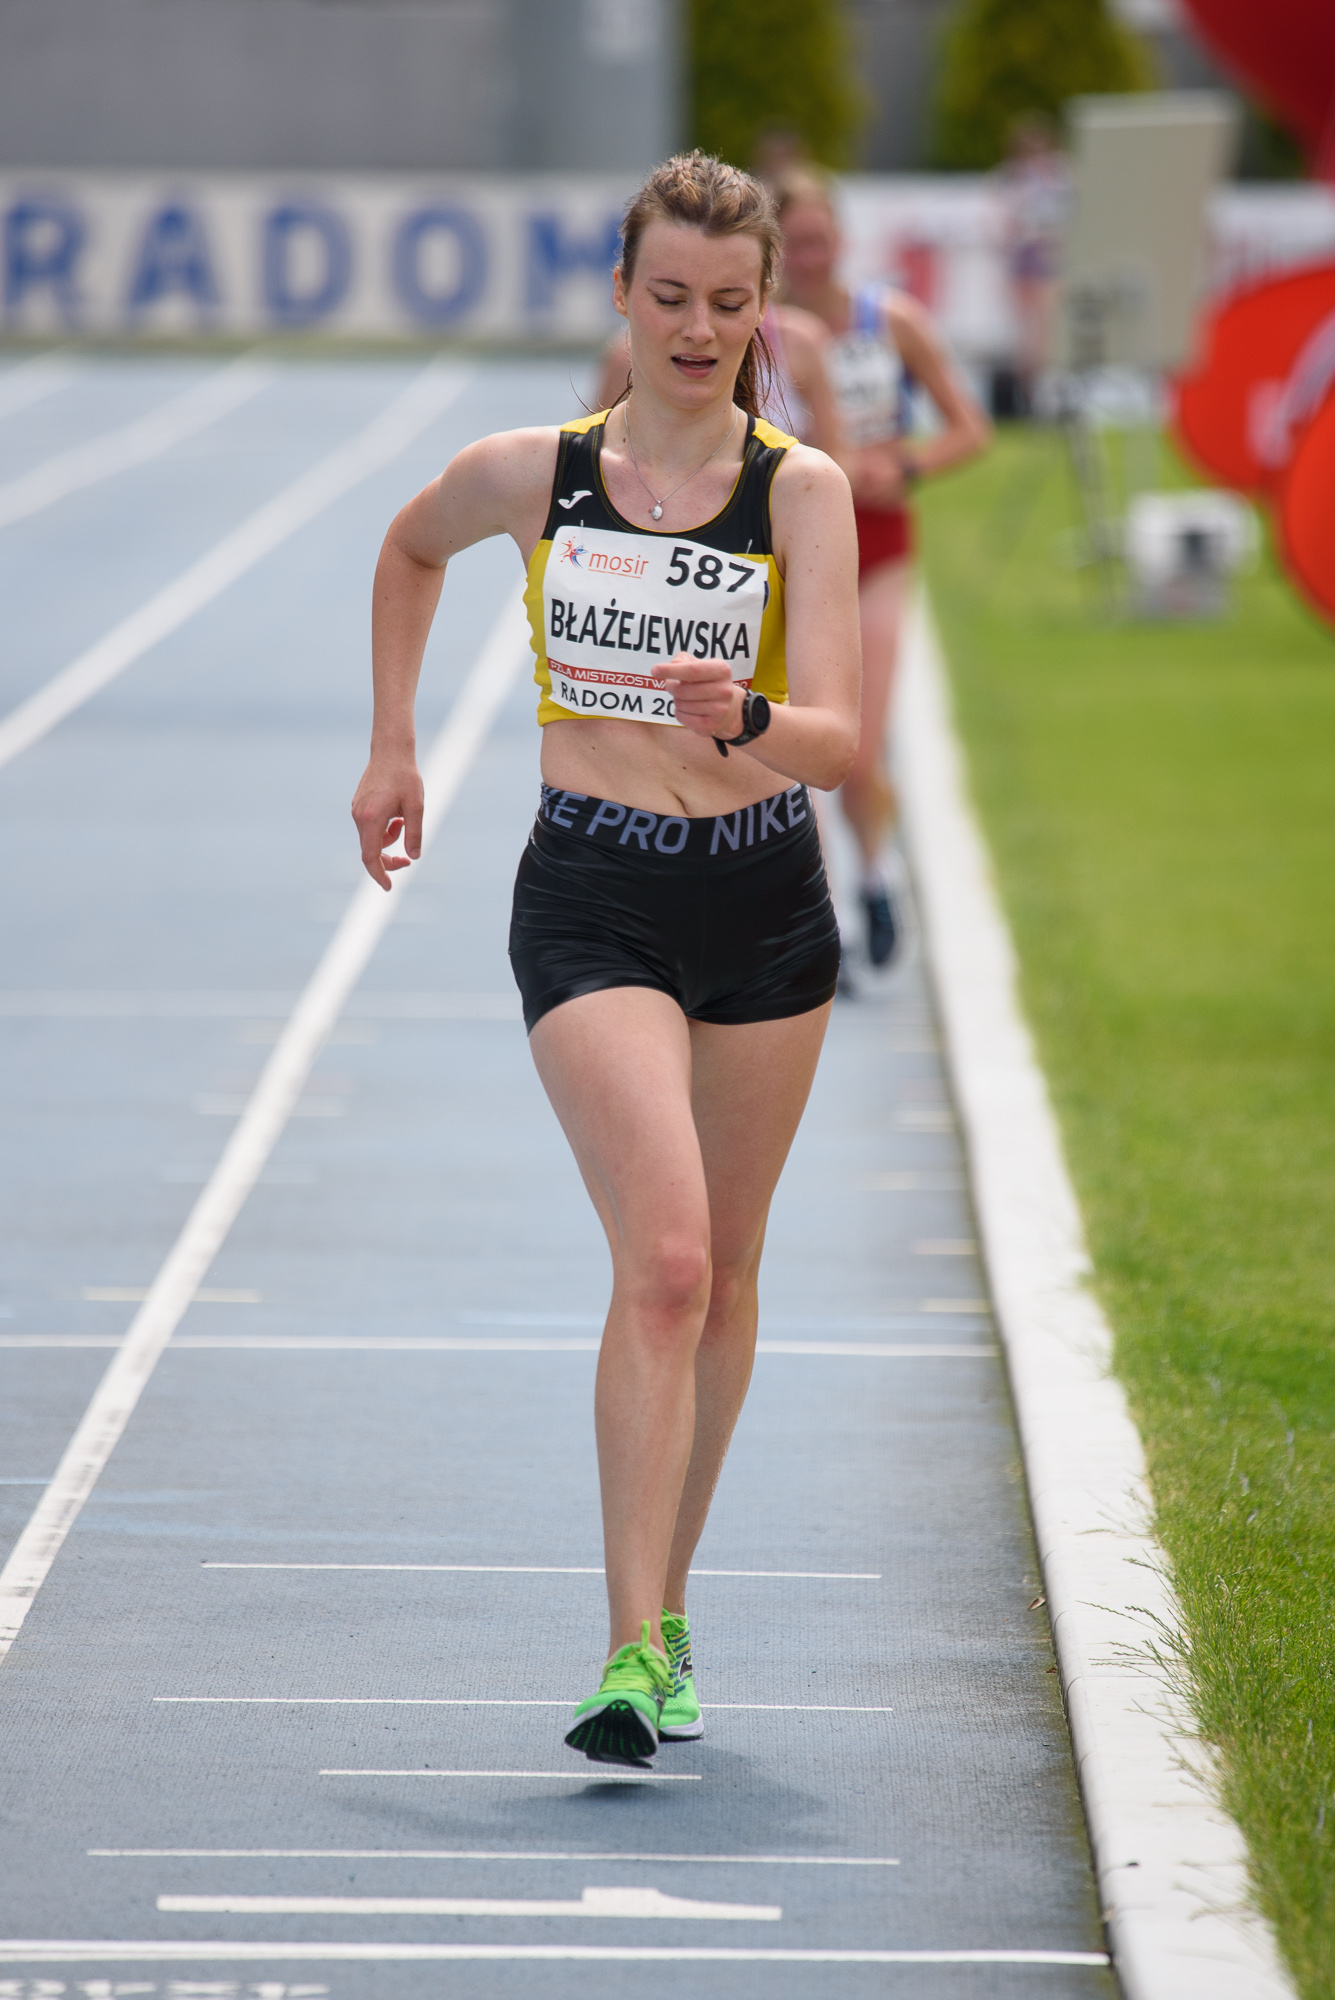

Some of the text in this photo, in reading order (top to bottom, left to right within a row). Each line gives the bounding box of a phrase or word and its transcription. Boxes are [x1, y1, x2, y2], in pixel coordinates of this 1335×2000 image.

[588, 553, 649, 575] mosir
[665, 547, 756, 593] 587
[550, 598, 750, 660] BŁAŻEJEWSKA
[550, 660, 573, 678] PZLA
[561, 681, 643, 713] RADOM
[585, 800, 690, 855] PRO
[709, 783, 807, 856] NIKE
